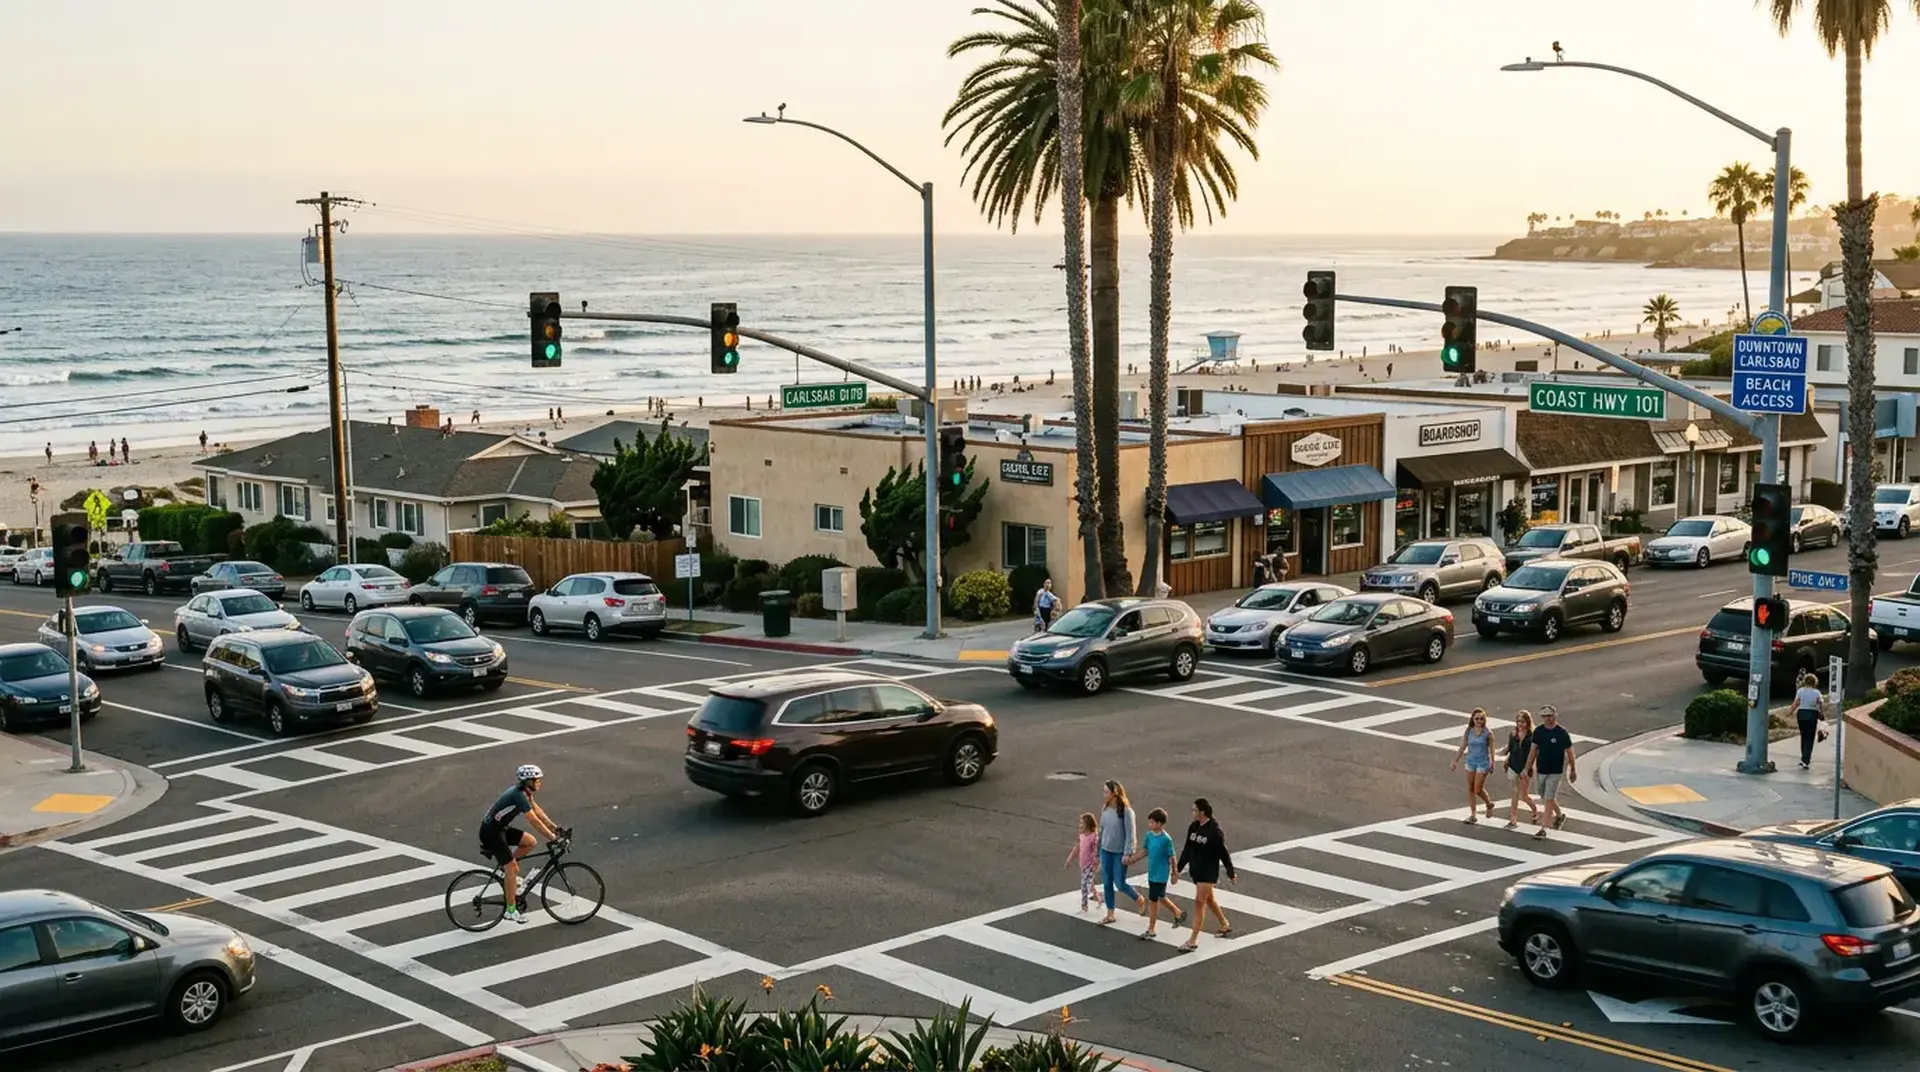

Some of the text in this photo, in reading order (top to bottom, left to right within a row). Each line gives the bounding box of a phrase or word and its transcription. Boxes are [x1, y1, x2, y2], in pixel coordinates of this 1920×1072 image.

[1746, 377, 1791, 391] BEACH
[1536, 389, 1659, 413] COAST HWY 101
[1741, 394, 1794, 408] ACCESS
